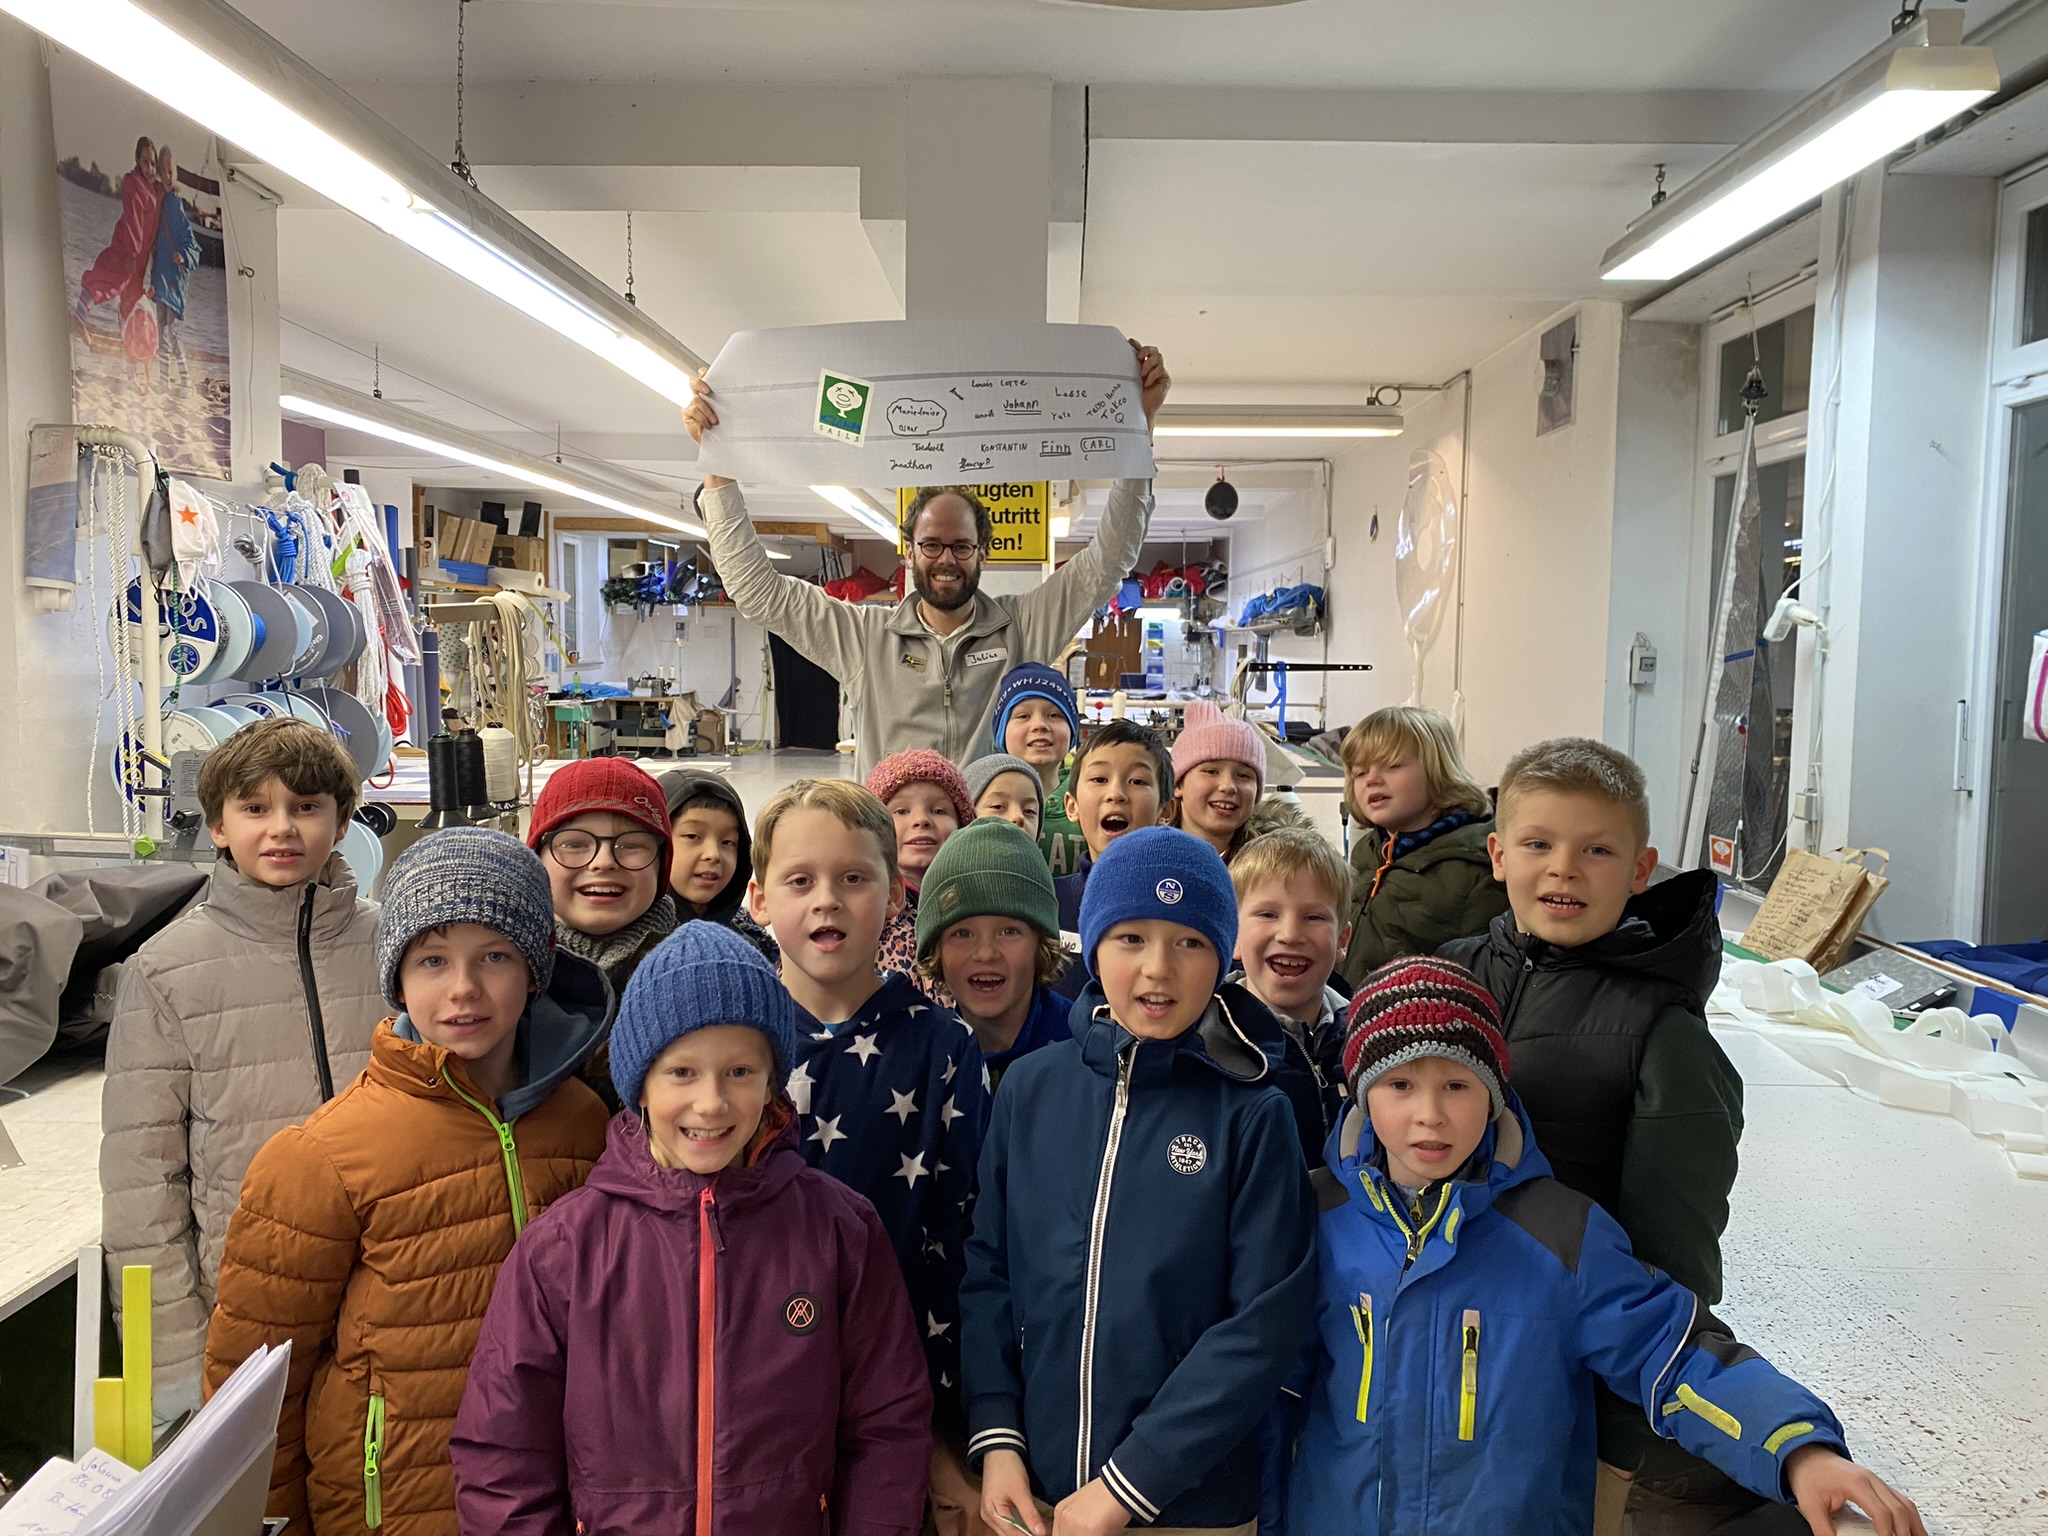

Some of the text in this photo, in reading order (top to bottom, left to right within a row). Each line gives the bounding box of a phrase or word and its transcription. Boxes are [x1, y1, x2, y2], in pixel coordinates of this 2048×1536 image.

[971, 379, 993, 388] Louis
[1055, 386, 1087, 398] Lasse
[1003, 399, 1039, 410] Johann
[819, 424, 860, 443] SAILS
[1041, 441, 1071, 453] Finn
[1082, 439, 1112, 450] CARL
[890, 459, 932, 470] Jonathan
[967, 653, 999, 664] Julius
[1176, 1136, 1202, 1150] TRACK
[1170, 1155, 1202, 1173] ATHLETICS
